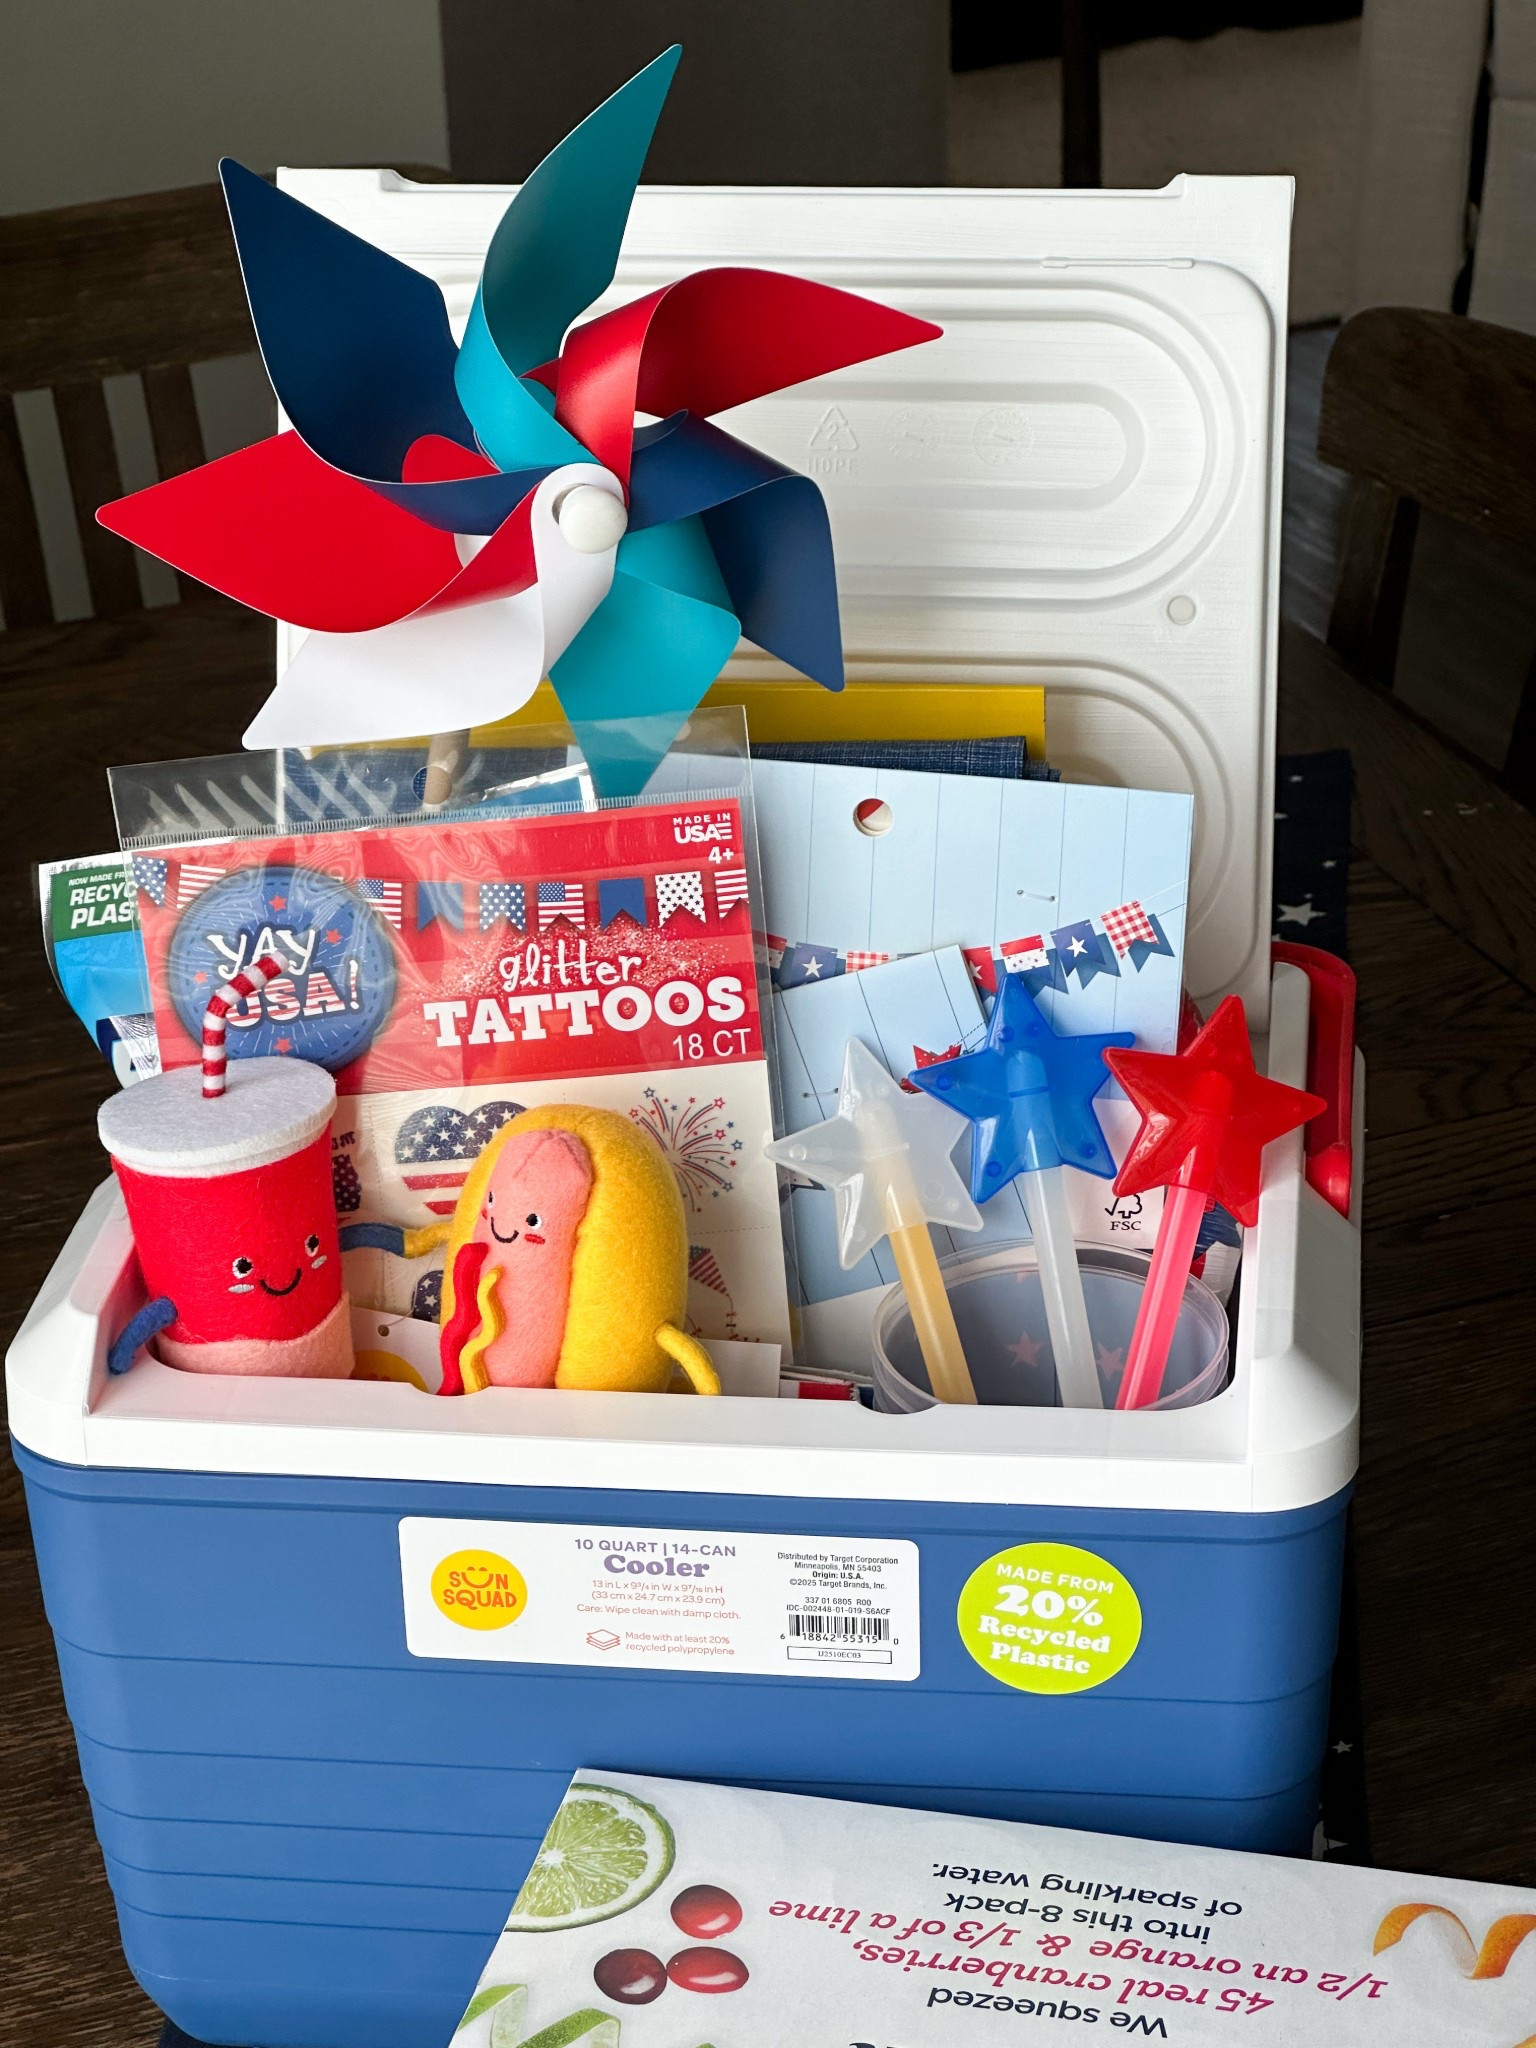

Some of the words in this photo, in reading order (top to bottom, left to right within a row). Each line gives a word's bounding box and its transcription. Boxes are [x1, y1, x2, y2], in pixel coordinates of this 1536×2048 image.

[673, 815, 711, 826] MADE
[717, 812, 731, 821] IN
[674, 823, 722, 844] USA
[708, 846, 734, 864] 4+
[68, 877, 88, 886] NOW
[89, 873, 113, 882] MADE
[69, 881, 137, 906] RECYC
[71, 901, 135, 929] PLAS
[206, 926, 316, 979] YAY
[499, 938, 642, 992] glitter
[225, 960, 359, 1028] USA!
[423, 976, 746, 1047] TATTOOS
[673, 1035, 704, 1061] 18
[713, 1028, 751, 1057] CT
[1110, 1221, 1142, 1231] FSC
[575, 1539, 593, 1550] 10
[599, 1540, 658, 1553] QUART
[672, 1544, 736, 1557] 14-CAN
[777, 1552, 818, 1561] Distributed
[820, 1553, 828, 1562] by
[830, 1554, 854, 1563] Target
[855, 1555, 899, 1565] Corporation
[604, 1554, 710, 1577] Cooler
[794, 1562, 840, 1571] Minneapolis,
[857, 1564, 882, 1573] 55403
[812, 1571, 839, 1580] Origin:
[840, 1572, 864, 1580] U.S.A.
[449, 1570, 508, 1590] SUN
[593, 1580, 604, 1589] 13
[605, 1581, 615, 1589] in
[615, 1581, 622, 1589] L
[651, 1583, 660, 1591] in
[662, 1583, 673, 1591] W
[819, 1580, 842, 1589] Target
[843, 1581, 872, 1590] Brands,
[873, 1582, 888, 1590] Inc.
[996, 1563, 1053, 1584] MADE
[1057, 1574, 1114, 1595] FROM
[443, 1588, 517, 1611] SQUAD
[592, 1591, 608, 1601] (33
[634, 1593, 655, 1601] 24.7
[682, 1595, 703, 1604] 23.9
[705, 1596, 725, 1606] cm)
[805, 1596, 819, 1604] 337
[821, 1597, 830, 1605] 01
[832, 1597, 852, 1605] 6805
[856, 1598, 872, 1606] R00
[994, 1584, 1104, 1627] 20%
[577, 1604, 603, 1613] Care:
[605, 1605, 630, 1616] Wipe
[632, 1606, 659, 1616] clean
[660, 1607, 681, 1617] with
[683, 1608, 711, 1619] damp
[713, 1609, 741, 1620] cloth.
[625, 1632, 651, 1641] Made
[652, 1632, 673, 1642] with
[674, 1634, 683, 1642] at
[685, 1634, 707, 1643] least
[709, 1636, 730, 1645] 20%
[802, 1632, 836, 1642] 18842
[842, 1635, 878, 1644] 55315
[978, 1615, 1111, 1653] Recycled
[626, 1642, 666, 1654] recycled
[667, 1644, 735, 1656] polypropylene
[990, 1642, 1091, 1674] Plastic
[932, 1864, 1029, 1887] water.
[1041, 1873, 1198, 1909] sparkling
[768, 1900, 861, 1934] lime
[943, 1893, 1063, 1923] 8-pack
[1204, 1900, 1243, 1917] of
[870, 1912, 897, 1929] a
[893, 1918, 945, 1940] of
[1073, 1908, 1133, 1933] this
[1144, 1919, 1211, 1945] into
[953, 1921, 1021, 1949] 1/3
[1036, 1933, 1072, 1957] &
[852, 1939, 1111, 1991] cranberries,
[1089, 1938, 1241, 1975] orange
[1252, 1963, 1308, 1984] an
[1117, 1978, 1208, 2005] real
[1317, 1972, 1389, 2001] 1/2
[927, 1987, 1101, 2023] squeezed
[1215, 1989, 1274, 2015] 45
[1110, 2011, 1168, 2038] We
